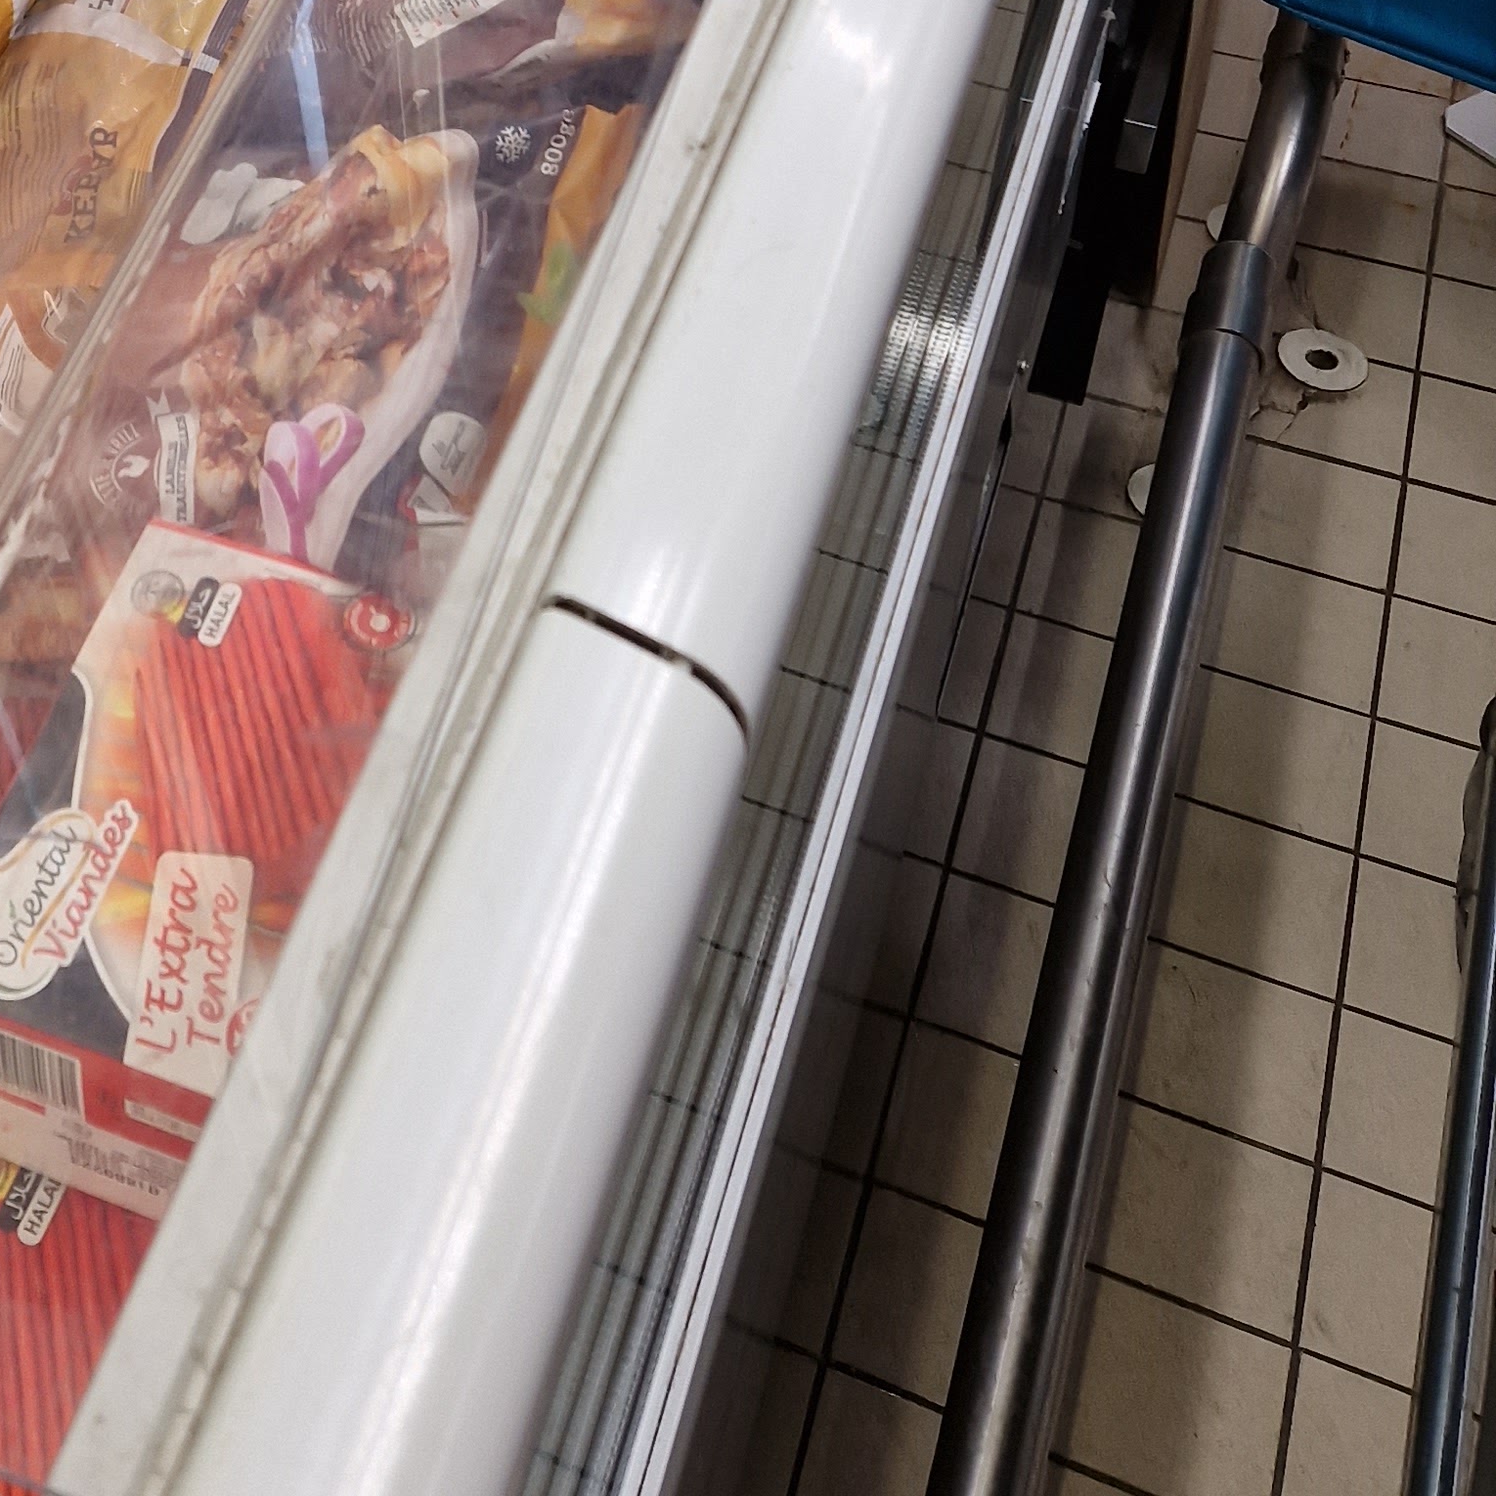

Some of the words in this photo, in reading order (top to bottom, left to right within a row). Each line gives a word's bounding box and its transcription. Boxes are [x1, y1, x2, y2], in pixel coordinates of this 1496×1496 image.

[203, 589, 237, 640] HALAL
[34, 808, 133, 962] Viandes
[134, 866, 199, 1056] L'Extra
[186, 881, 241, 1049] Tendre
